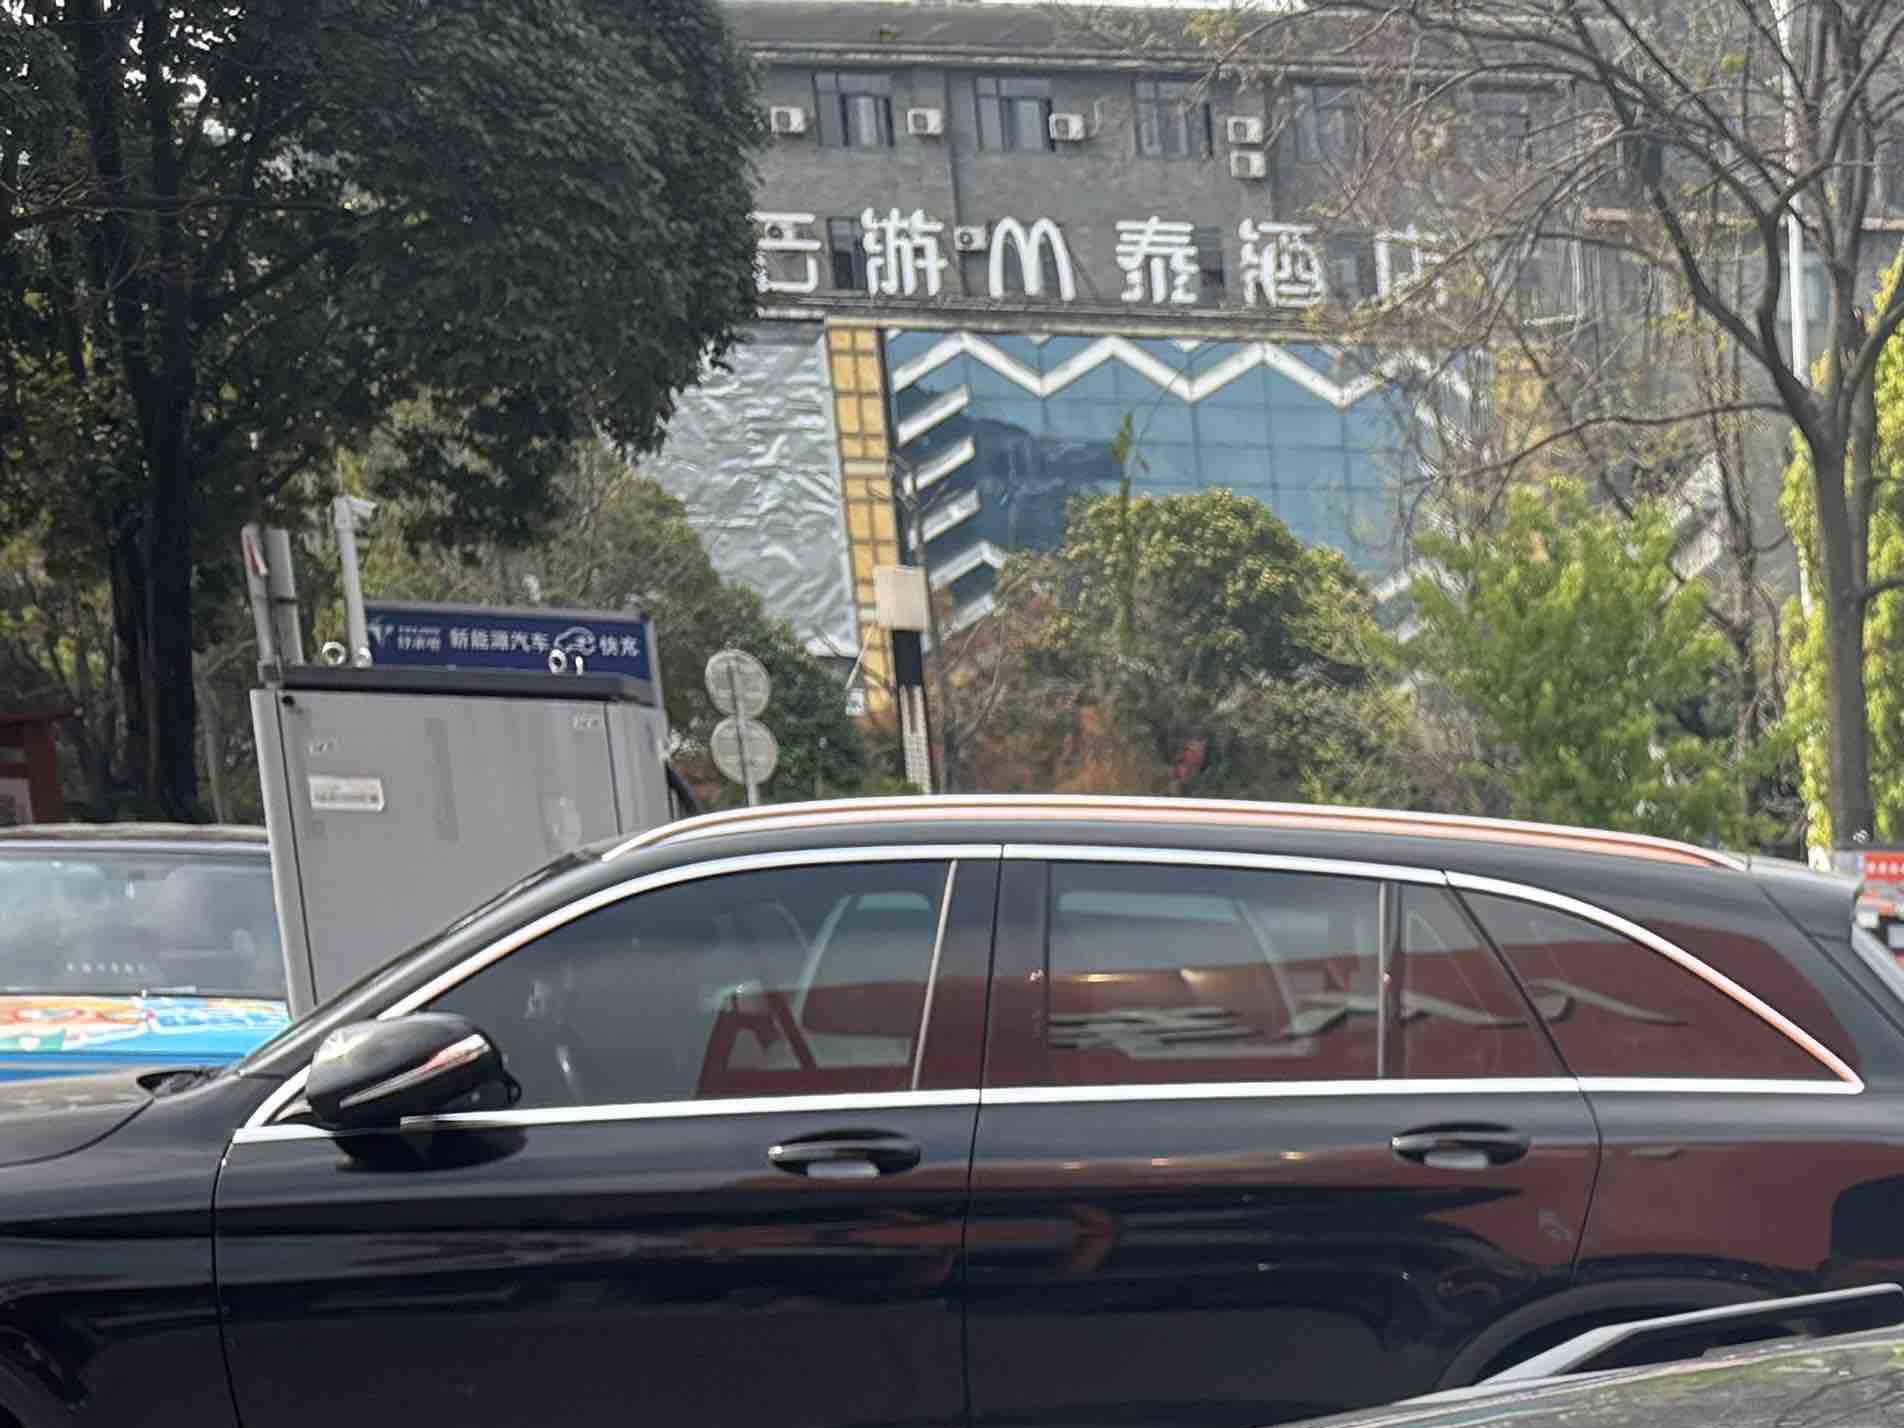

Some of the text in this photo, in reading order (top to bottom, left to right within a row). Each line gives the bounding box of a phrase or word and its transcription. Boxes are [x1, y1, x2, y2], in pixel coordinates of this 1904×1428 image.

[450, 626, 550, 652] 新能源汽车
[600, 635, 641, 657] 快充
